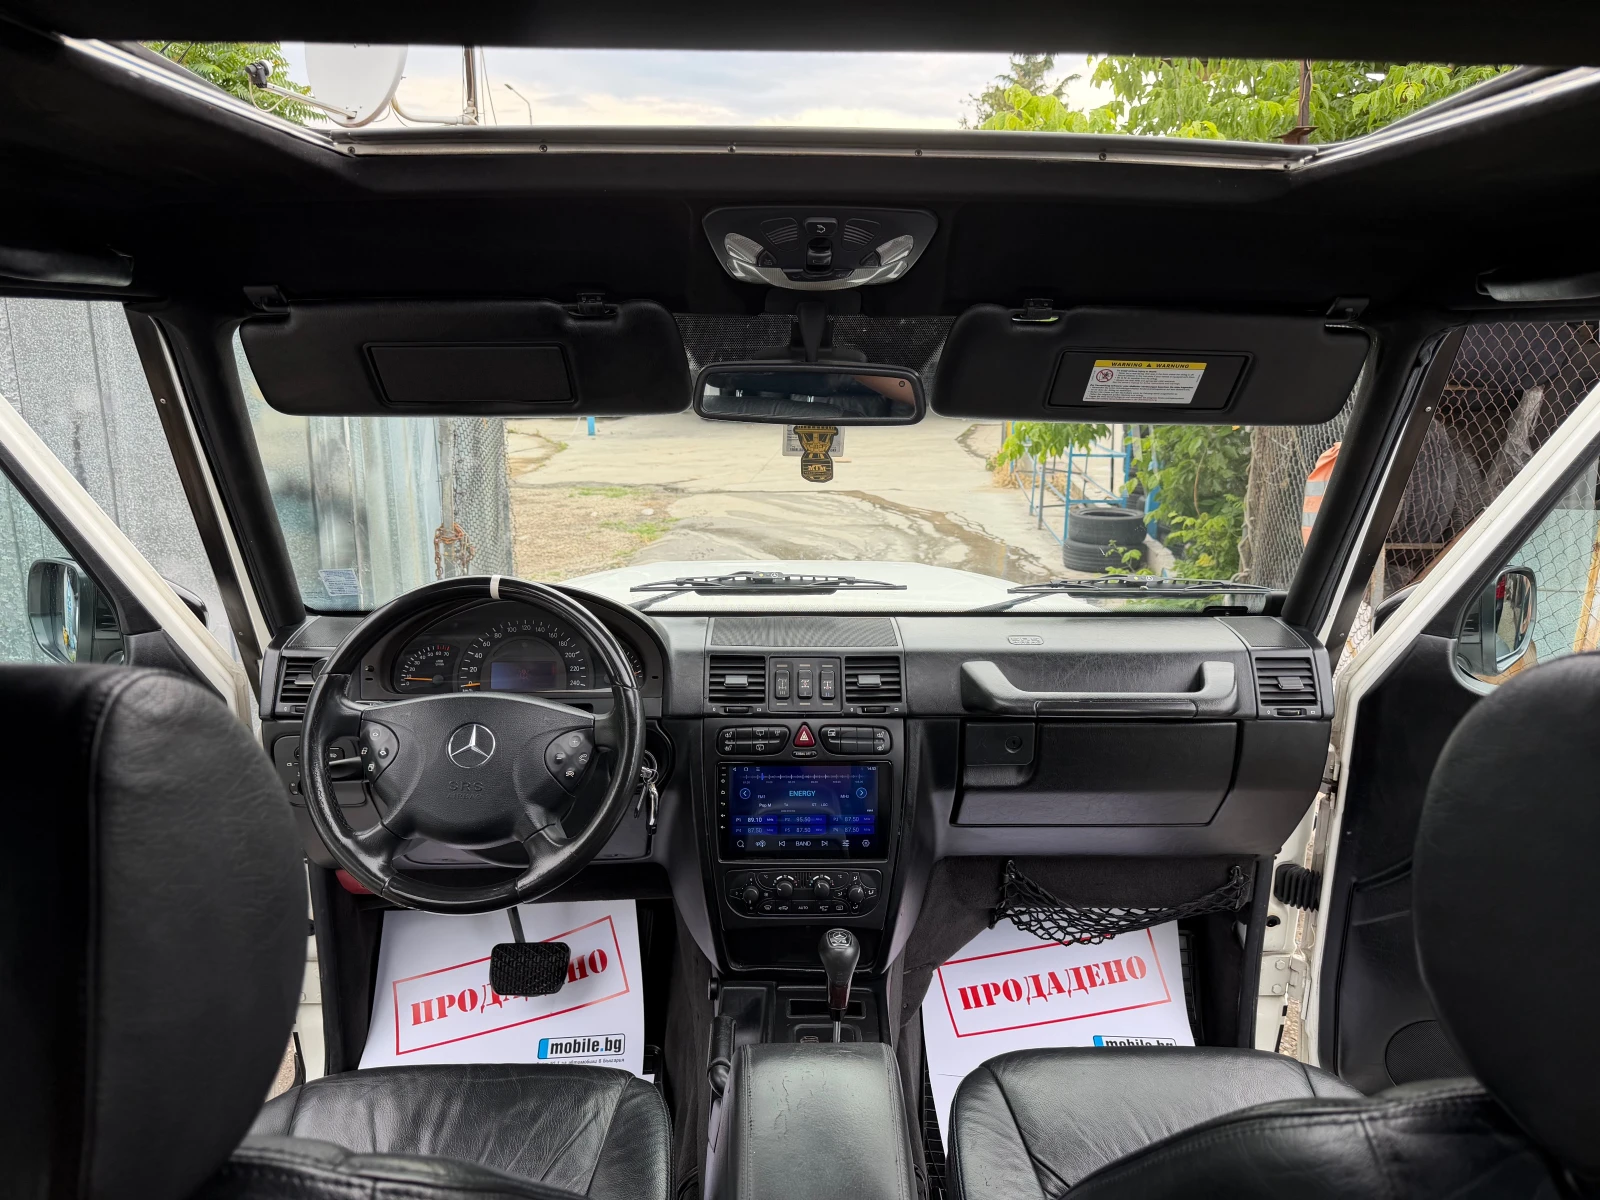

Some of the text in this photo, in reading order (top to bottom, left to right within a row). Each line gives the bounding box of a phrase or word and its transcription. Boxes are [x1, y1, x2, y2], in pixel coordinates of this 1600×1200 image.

[448, 780, 483, 791] SRS
[957, 955, 1148, 1012] ПРОДАДЕНО
[550, 1037, 622, 1054] mobile.bg
